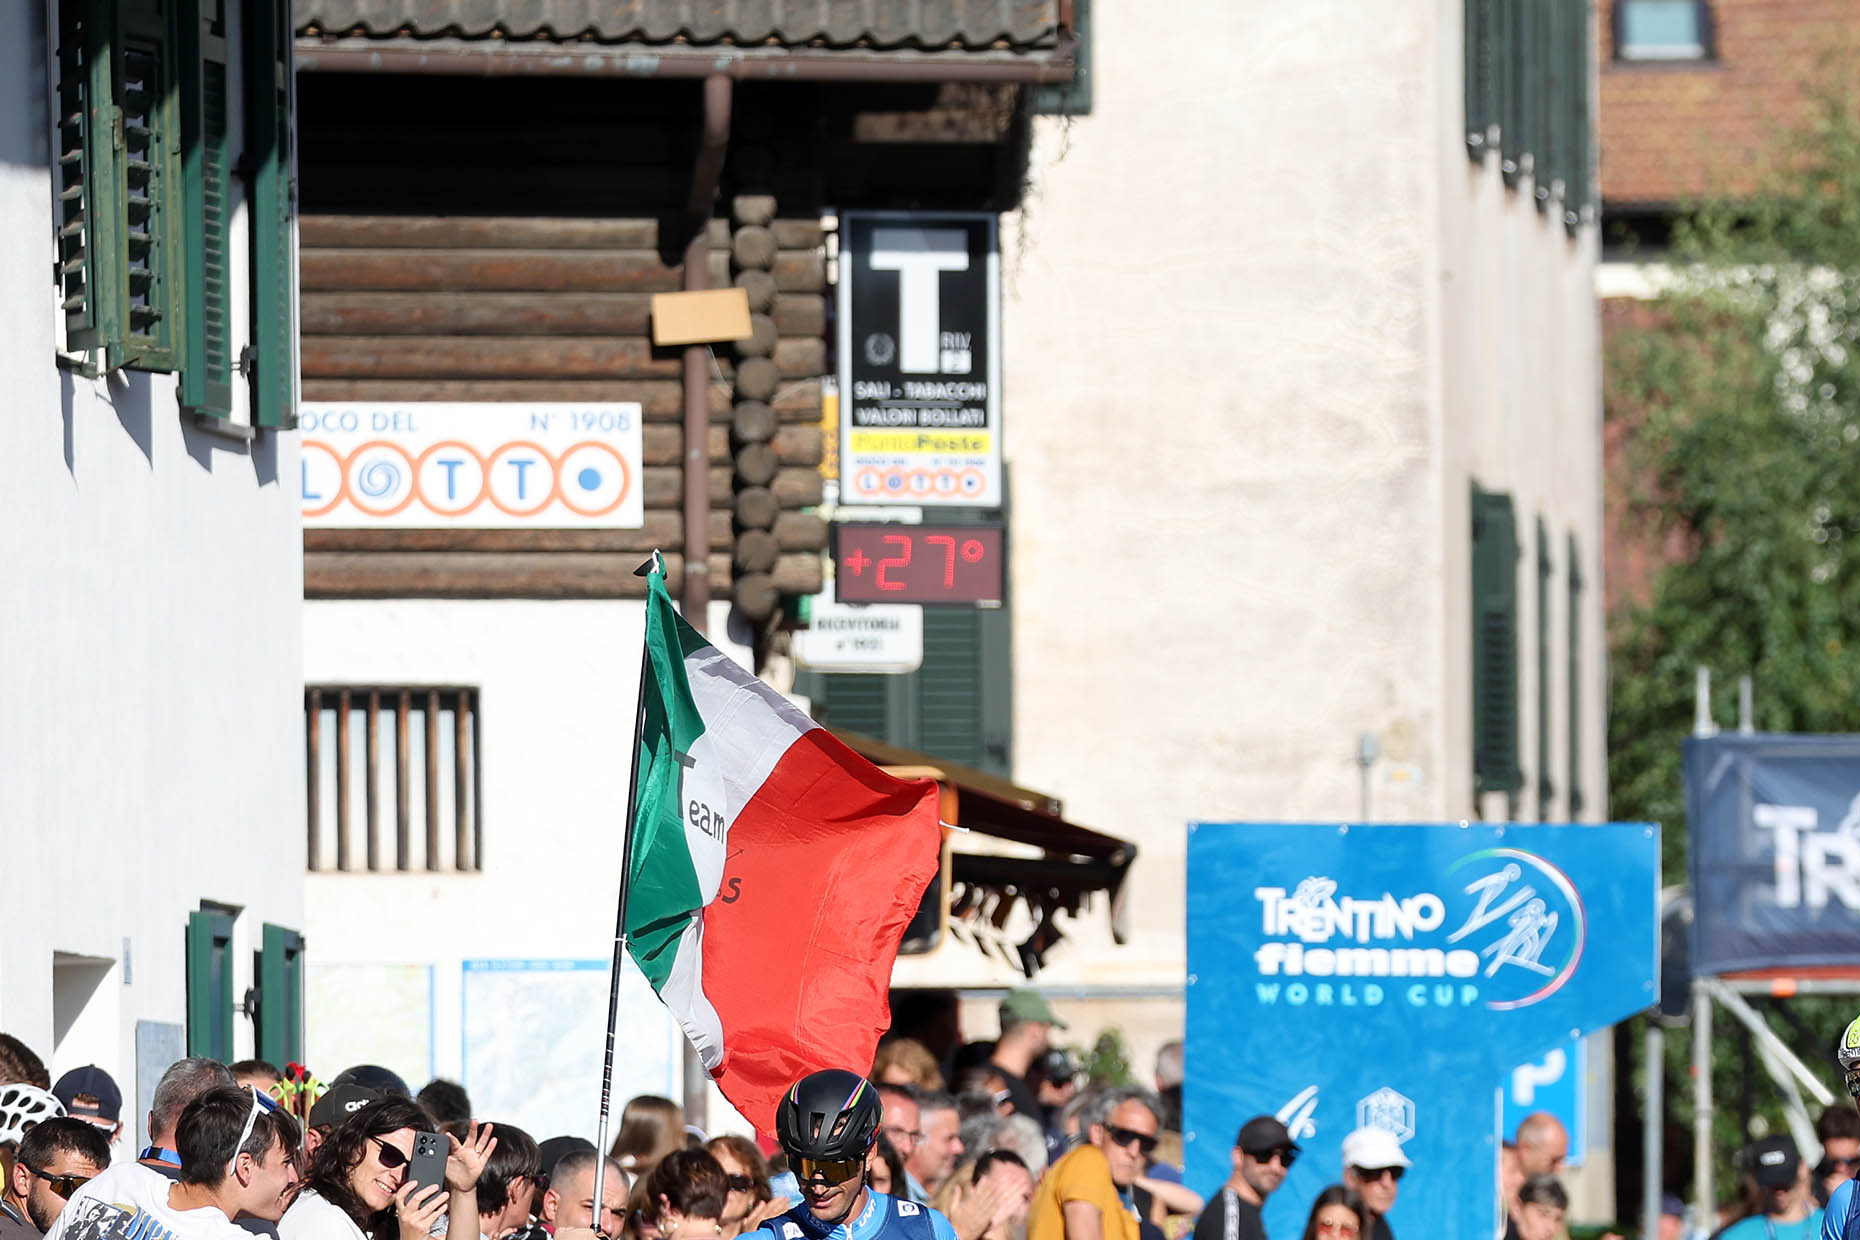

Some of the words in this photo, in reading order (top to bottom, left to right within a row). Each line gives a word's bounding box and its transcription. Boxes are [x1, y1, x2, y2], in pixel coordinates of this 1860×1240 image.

[869, 229, 969, 373] T
[371, 411, 417, 432] DEL
[571, 411, 632, 432] 1908
[673, 749, 726, 845] Team
[1254, 884, 1446, 943] TRENTINO
[1254, 943, 1480, 978] fiemme
[1256, 982, 1384, 1007] WORLD
[1406, 984, 1480, 1007] CUP
